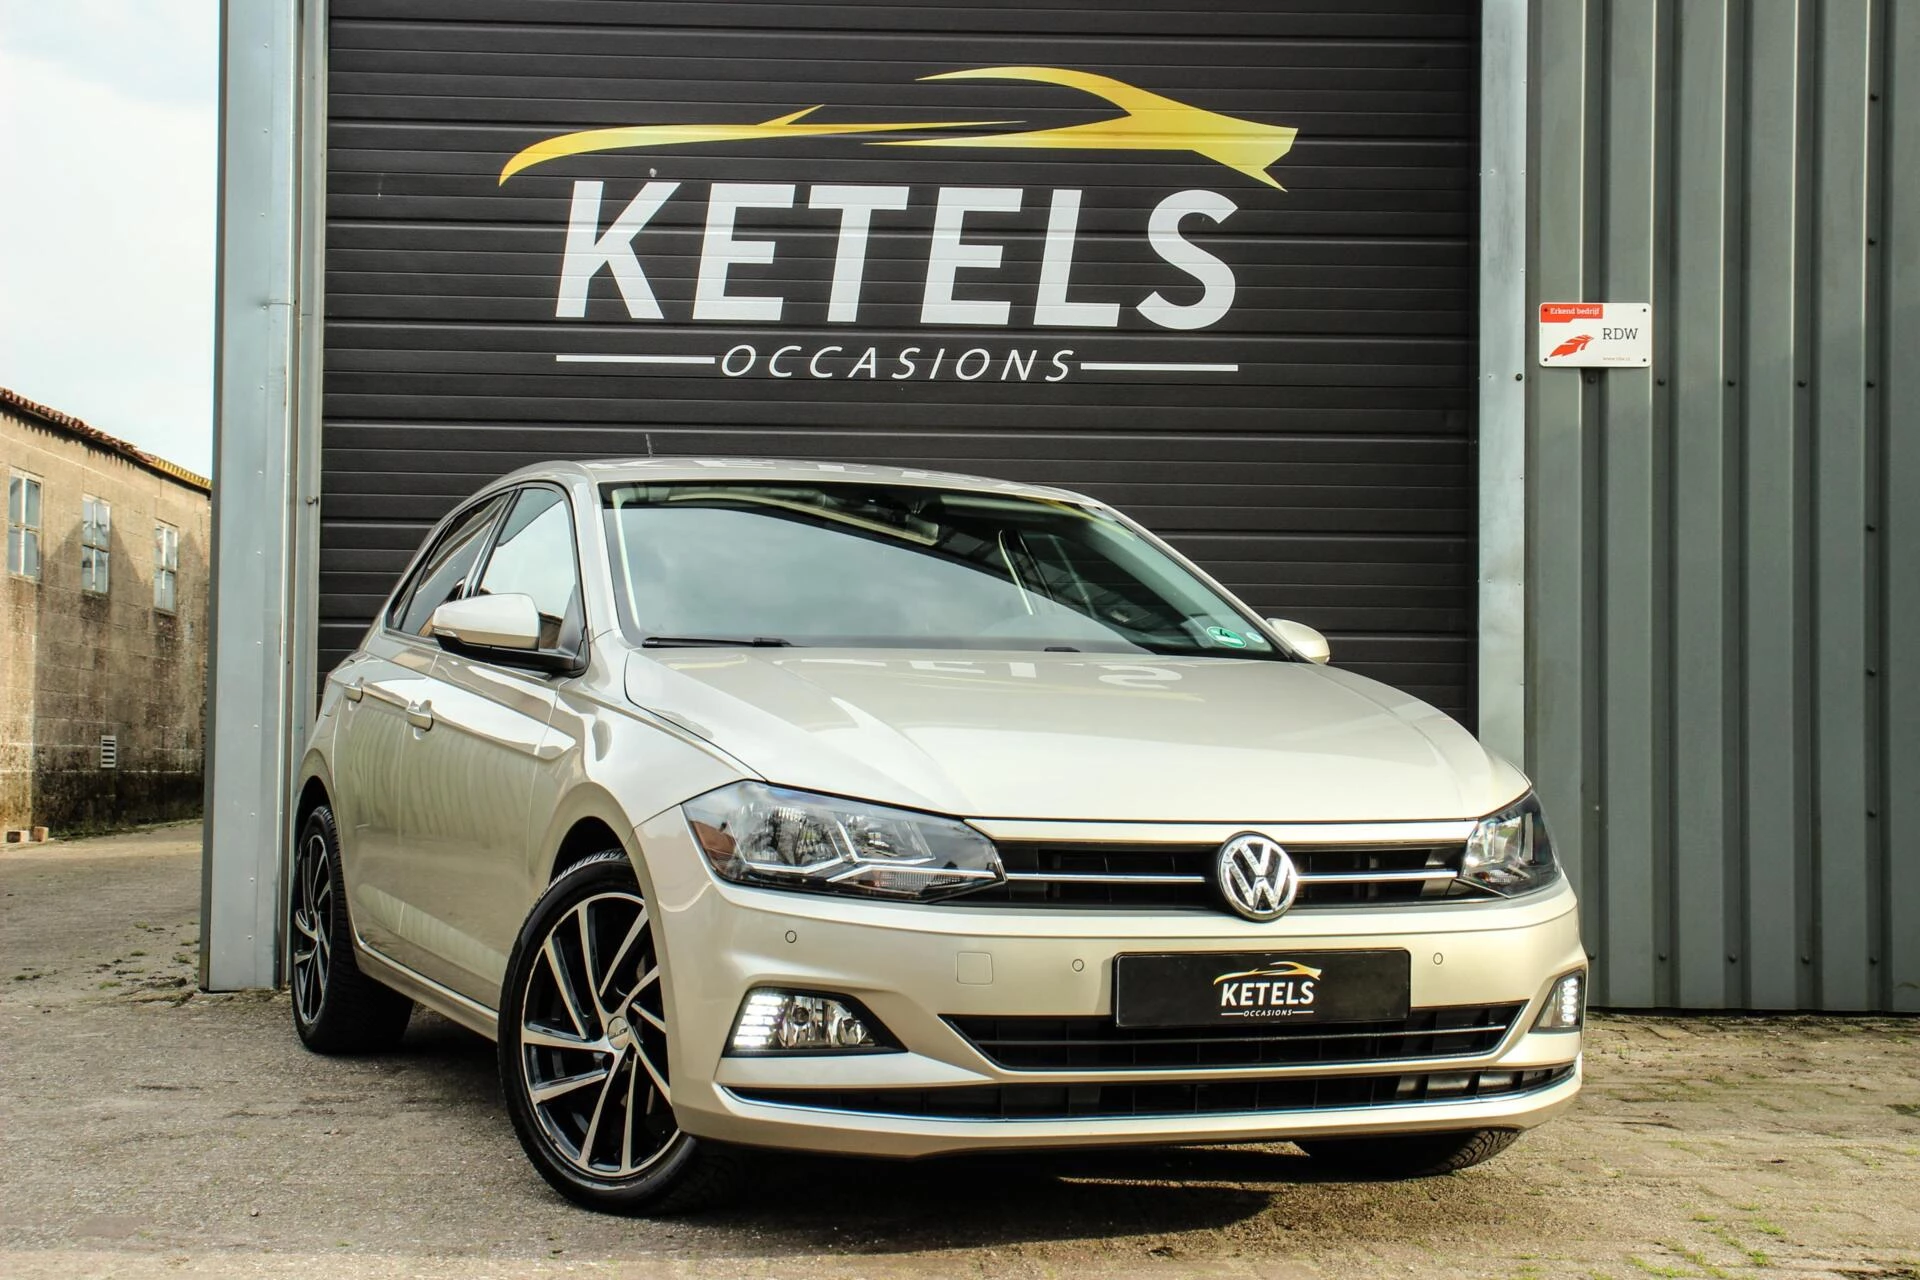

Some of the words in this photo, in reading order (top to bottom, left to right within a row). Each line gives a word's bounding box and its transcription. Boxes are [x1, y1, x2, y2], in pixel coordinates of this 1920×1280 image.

[555, 180, 1239, 331] KETELS
[1550, 307, 1575, 315] Erkend
[1576, 307, 1600, 317] bedrijf
[1602, 327, 1639, 340] RDW
[720, 344, 1074, 383] OCCASIONS
[1221, 981, 1315, 1006] KETELS
[1243, 1009, 1293, 1017] OCCASIONS
